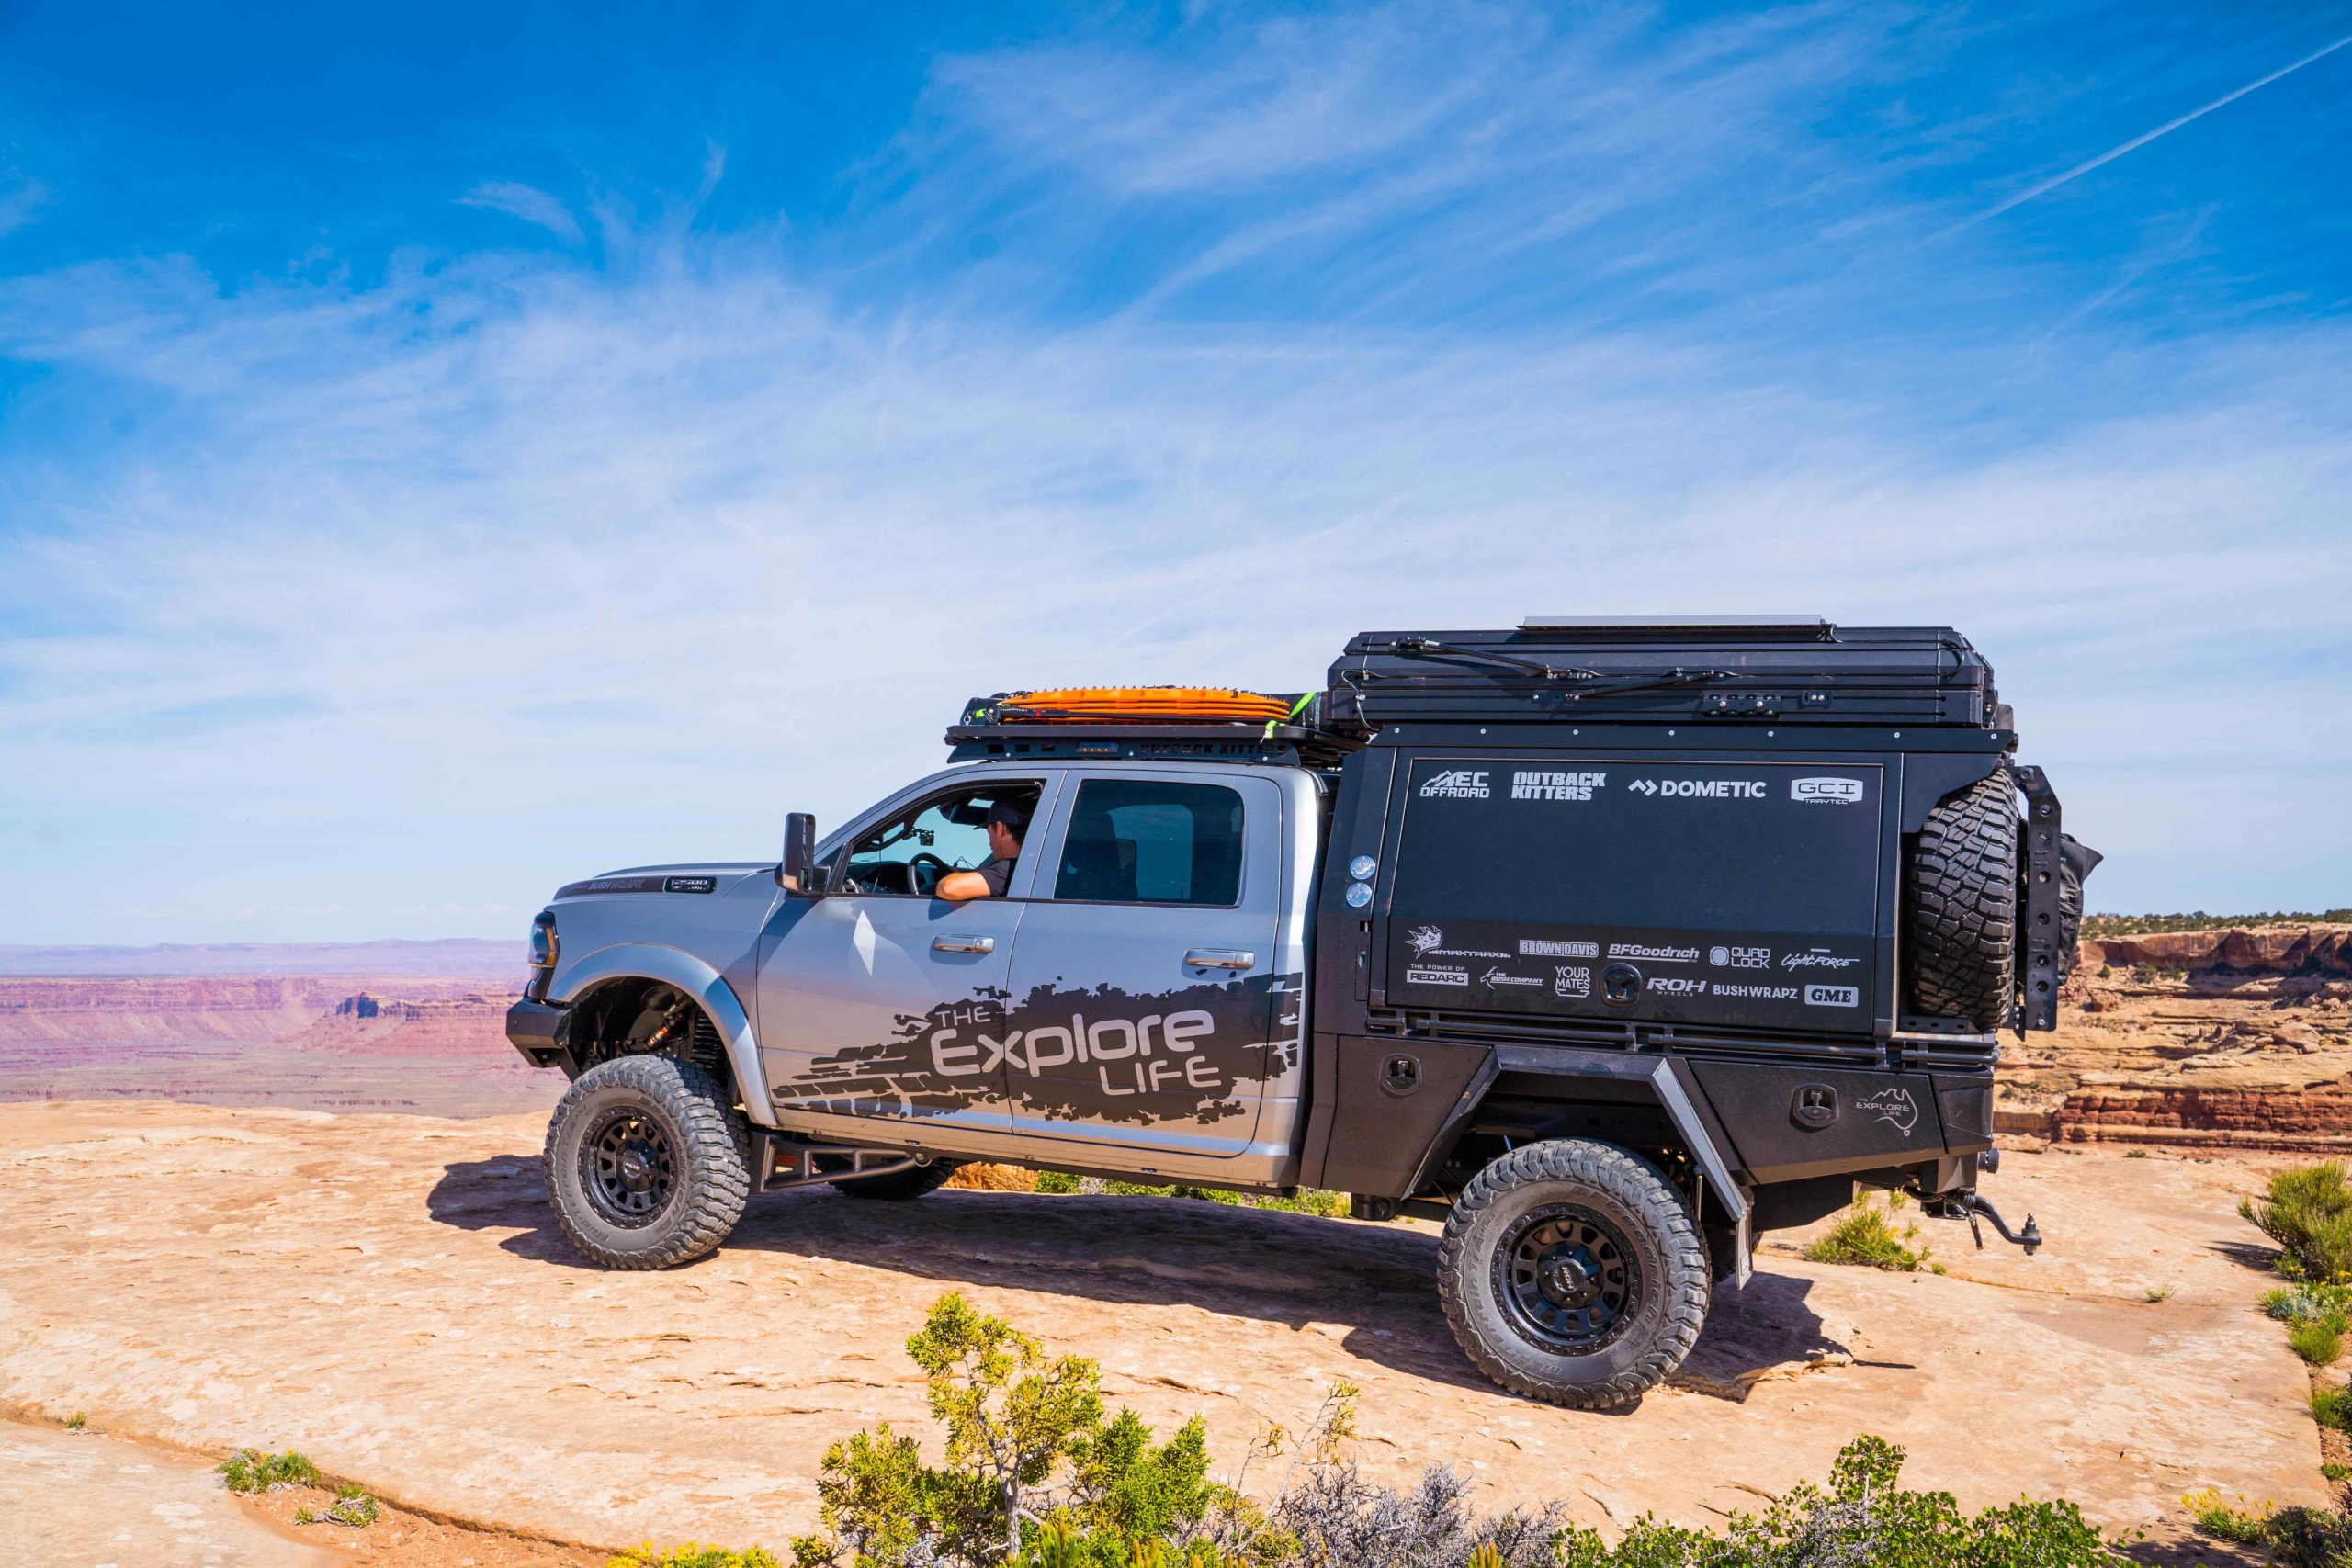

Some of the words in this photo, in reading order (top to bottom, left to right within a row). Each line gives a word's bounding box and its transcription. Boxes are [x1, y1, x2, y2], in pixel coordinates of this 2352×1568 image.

[1512, 771, 1607, 787] OUTBACK
[1419, 786, 1490, 798] OFFROAD
[1510, 784, 1594, 801] KITTERS
[1660, 780, 1768, 798] DOMETIC
[1797, 782, 1857, 795] GCI
[1436, 949, 1503, 959] MAXTRAX
[1608, 943, 1700, 959] BFGoodrich
[1731, 947, 1770, 959] QUAD
[1731, 957, 1770, 969] LOCK
[1410, 972, 1464, 983] REDARC
[1555, 966, 1590, 980] YOUR
[1555, 978, 1590, 990] MATES
[1646, 977, 1707, 993] ROH
[1810, 987, 1852, 1003] GME
[935, 1006, 991, 1028] THE
[930, 1010, 1215, 1078] Explore
[1099, 1055, 1222, 1096] LIFE
[1856, 1101, 1910, 1111] EXPLORE
[1569, 1184, 1662, 1325] BFGoodrich
[1561, 1265, 1575, 1290] ROH
